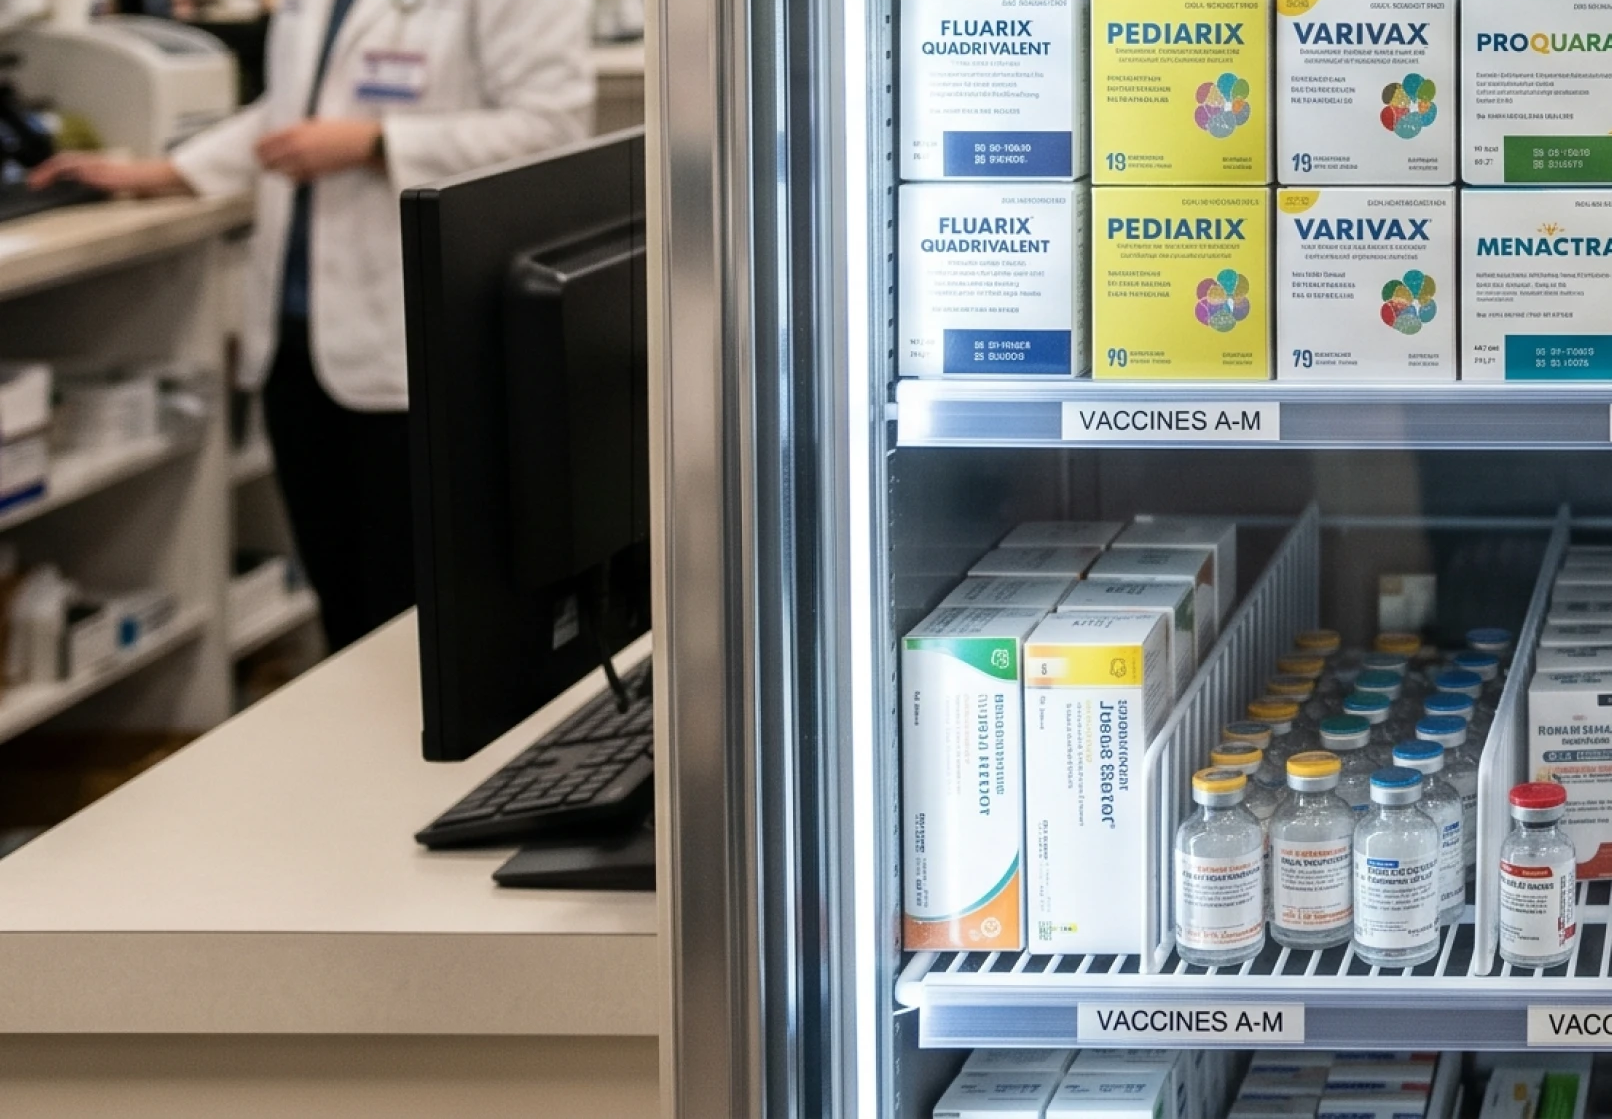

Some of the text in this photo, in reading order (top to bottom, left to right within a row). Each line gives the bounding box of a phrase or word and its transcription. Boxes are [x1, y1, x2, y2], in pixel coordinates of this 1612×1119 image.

[940, 19, 1033, 37] FLUARIX
[1106, 22, 1246, 45] PEDIARIX
[1292, 22, 1430, 46] VARIVAX
[921, 40, 1052, 56] QUADRIVALENT
[938, 217, 1033, 236] FLUARIX
[1106, 217, 1247, 241] PEDIARIX
[1293, 217, 1431, 241] VARIVAX
[920, 238, 1051, 255] QUADRIVALENT
[1079, 410, 1261, 431] VACCINES A-M
[1096, 1010, 1284, 1032] VACCINES A-M
